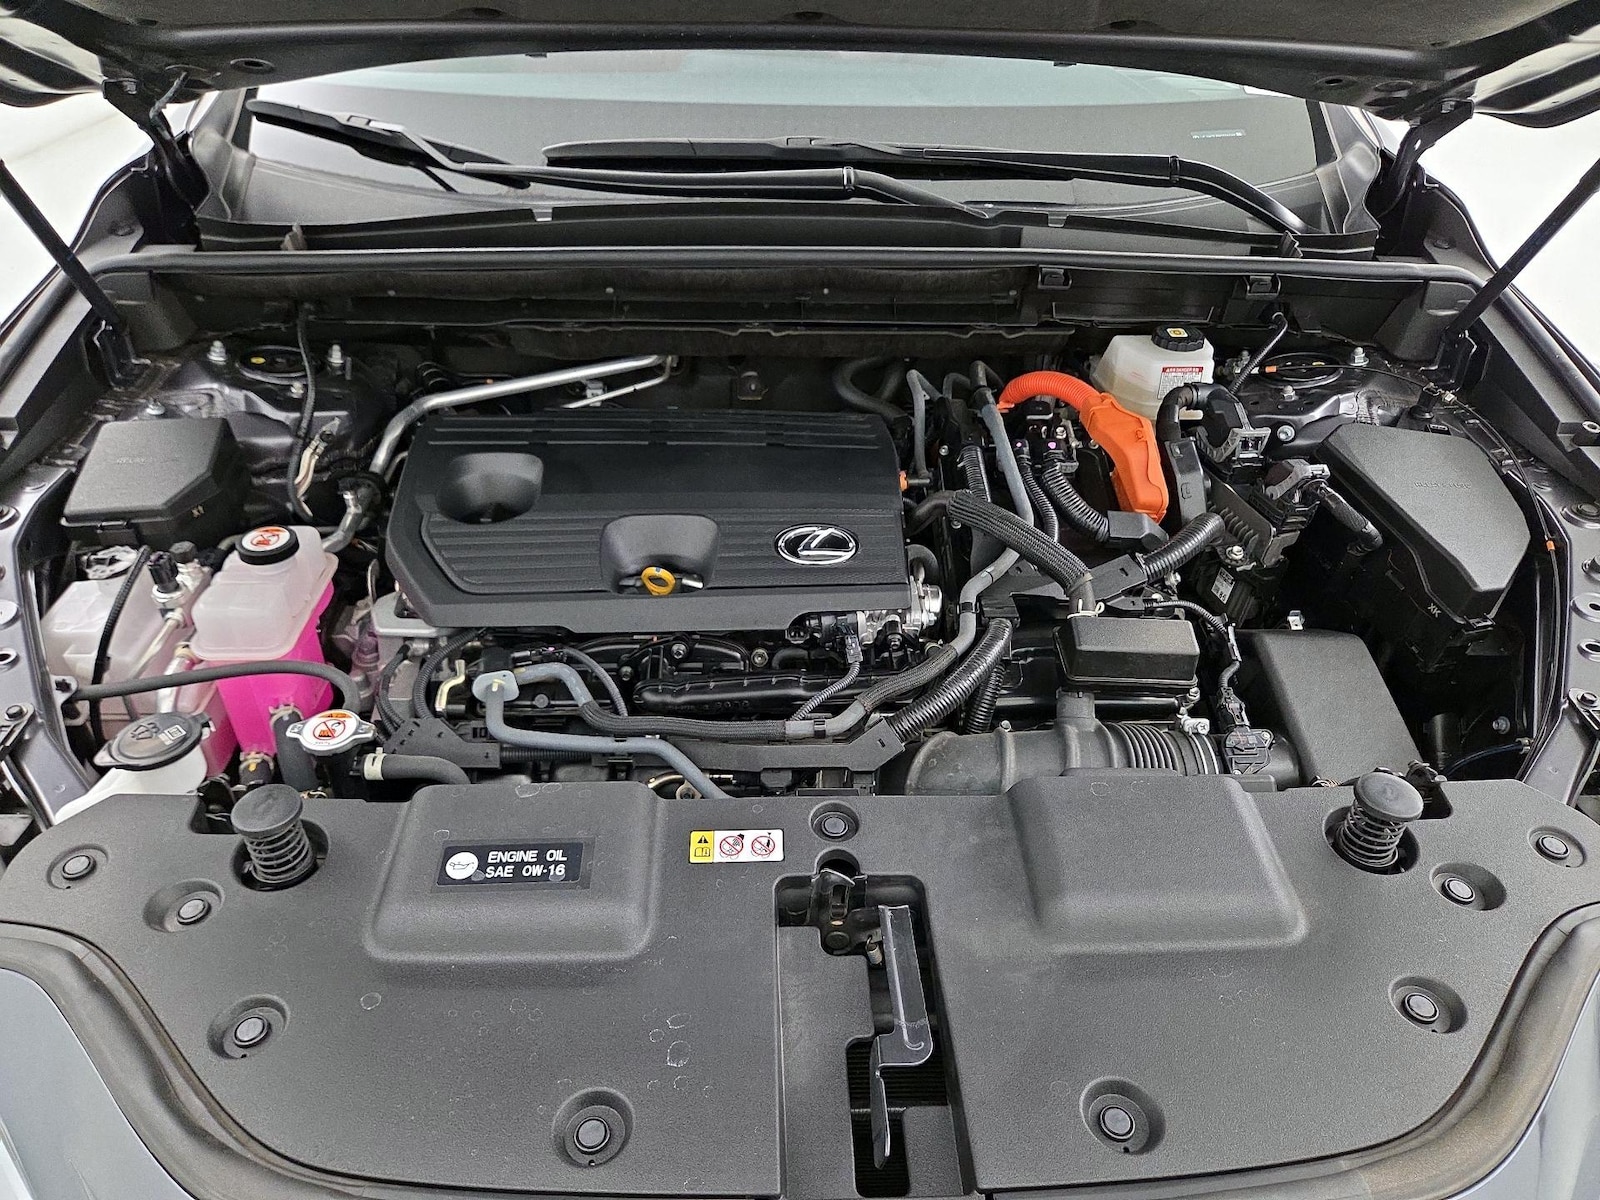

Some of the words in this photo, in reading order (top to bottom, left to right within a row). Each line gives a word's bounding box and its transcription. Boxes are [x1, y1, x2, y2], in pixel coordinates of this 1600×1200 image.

[487, 850, 539, 863] ENGINE
[545, 849, 568, 862] OIL
[485, 865, 515, 878] SAE
